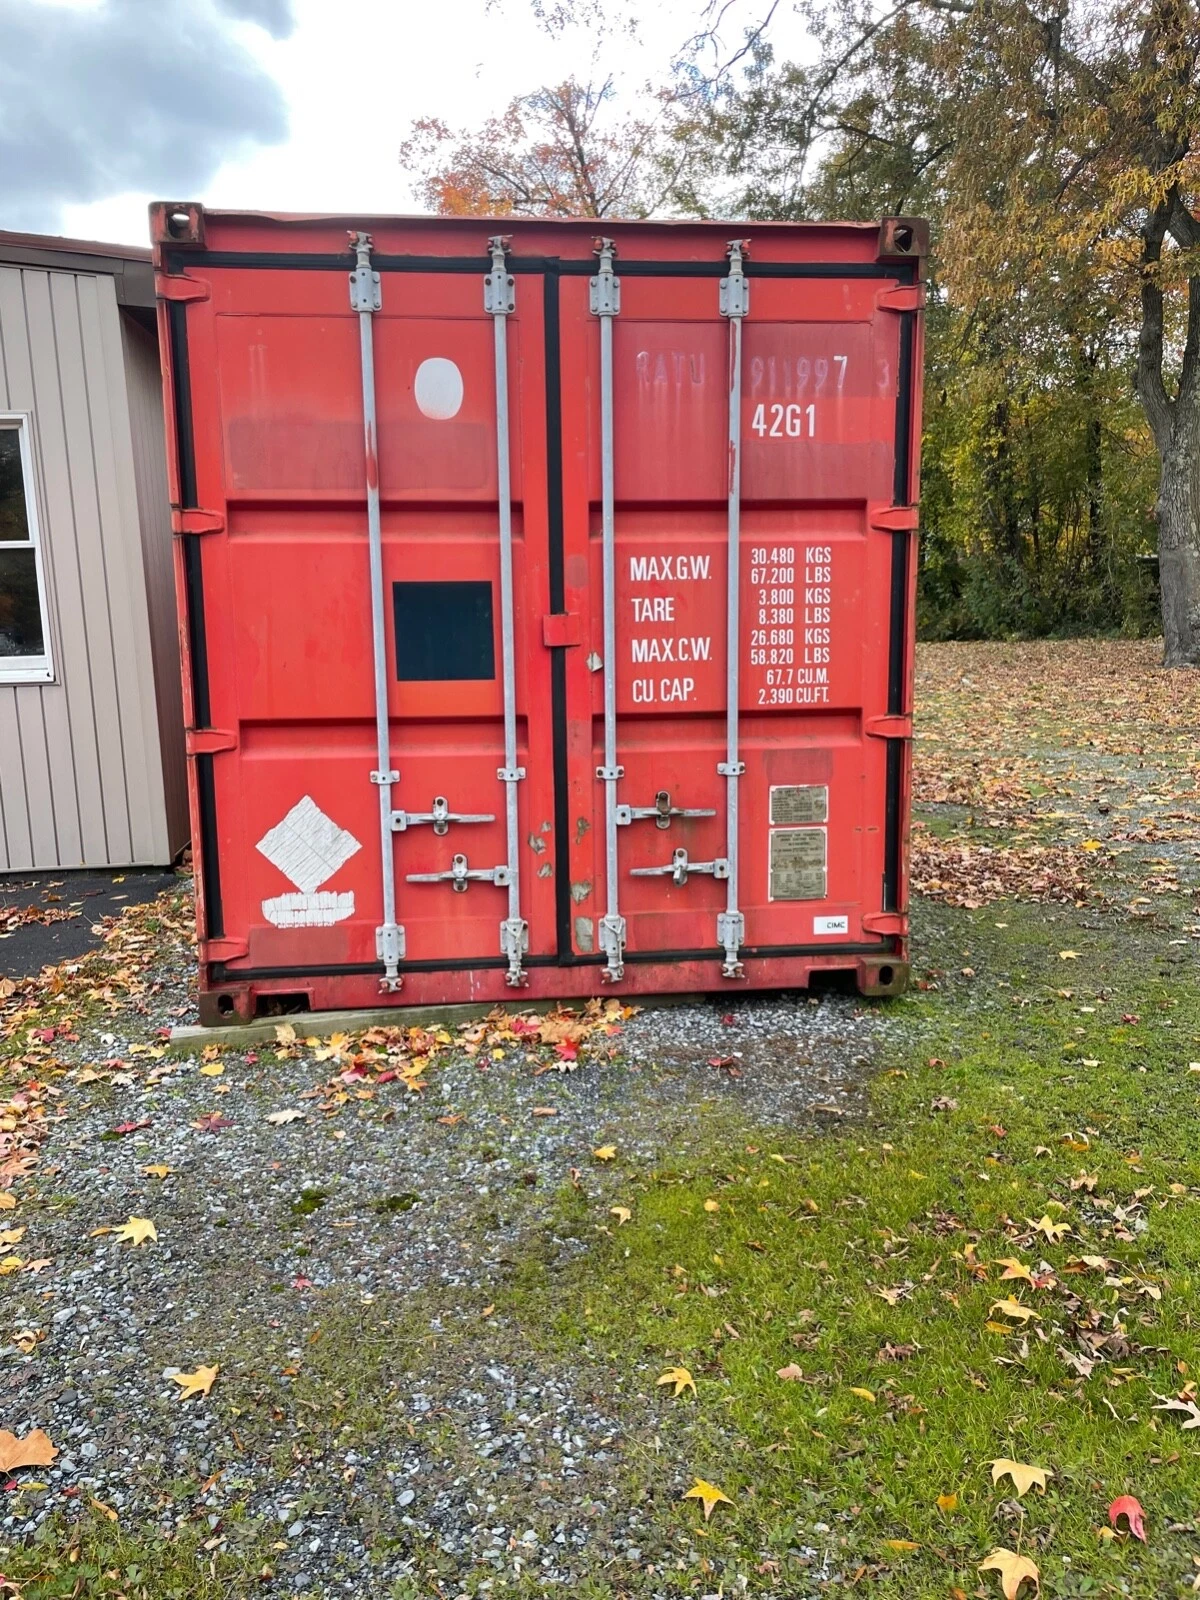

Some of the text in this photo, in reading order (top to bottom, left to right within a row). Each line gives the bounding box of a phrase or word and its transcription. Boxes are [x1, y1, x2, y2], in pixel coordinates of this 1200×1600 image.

[751, 403, 815, 437] 42G1
[806, 546, 832, 564] KGS
[630, 555, 712, 581] MAX.G.W.
[805, 566, 832, 583] LBS
[805, 587, 831, 604] KGS
[631, 597, 675, 622] TARE
[804, 607, 831, 624] LBS
[804, 628, 830, 644] KGS
[631, 637, 713, 663] MAX.C.W.
[804, 647, 830, 664] LBS
[766, 667, 830, 685] 67.7 CU.M.
[826, 921, 846, 929] CIMC
